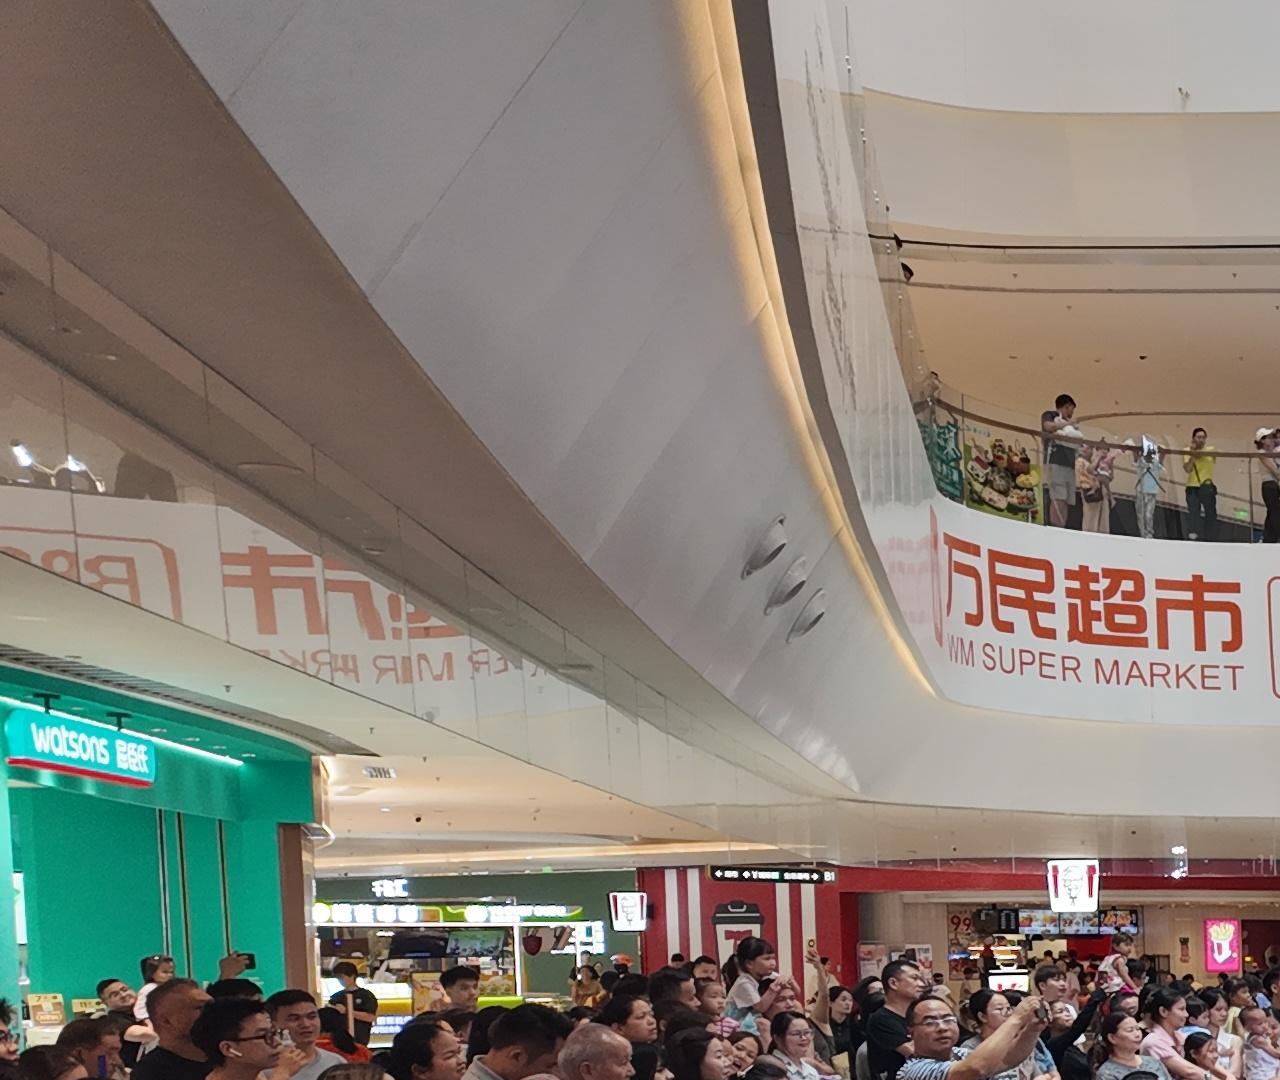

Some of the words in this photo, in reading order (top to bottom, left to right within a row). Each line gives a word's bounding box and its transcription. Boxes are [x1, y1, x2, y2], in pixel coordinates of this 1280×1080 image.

[943, 531, 1244, 654] 万民超市
[947, 634, 975, 668] WM
[981, 642, 1082, 684] SUPER
[1095, 657, 1244, 692] MARKET
[31, 723, 110, 765] watsons
